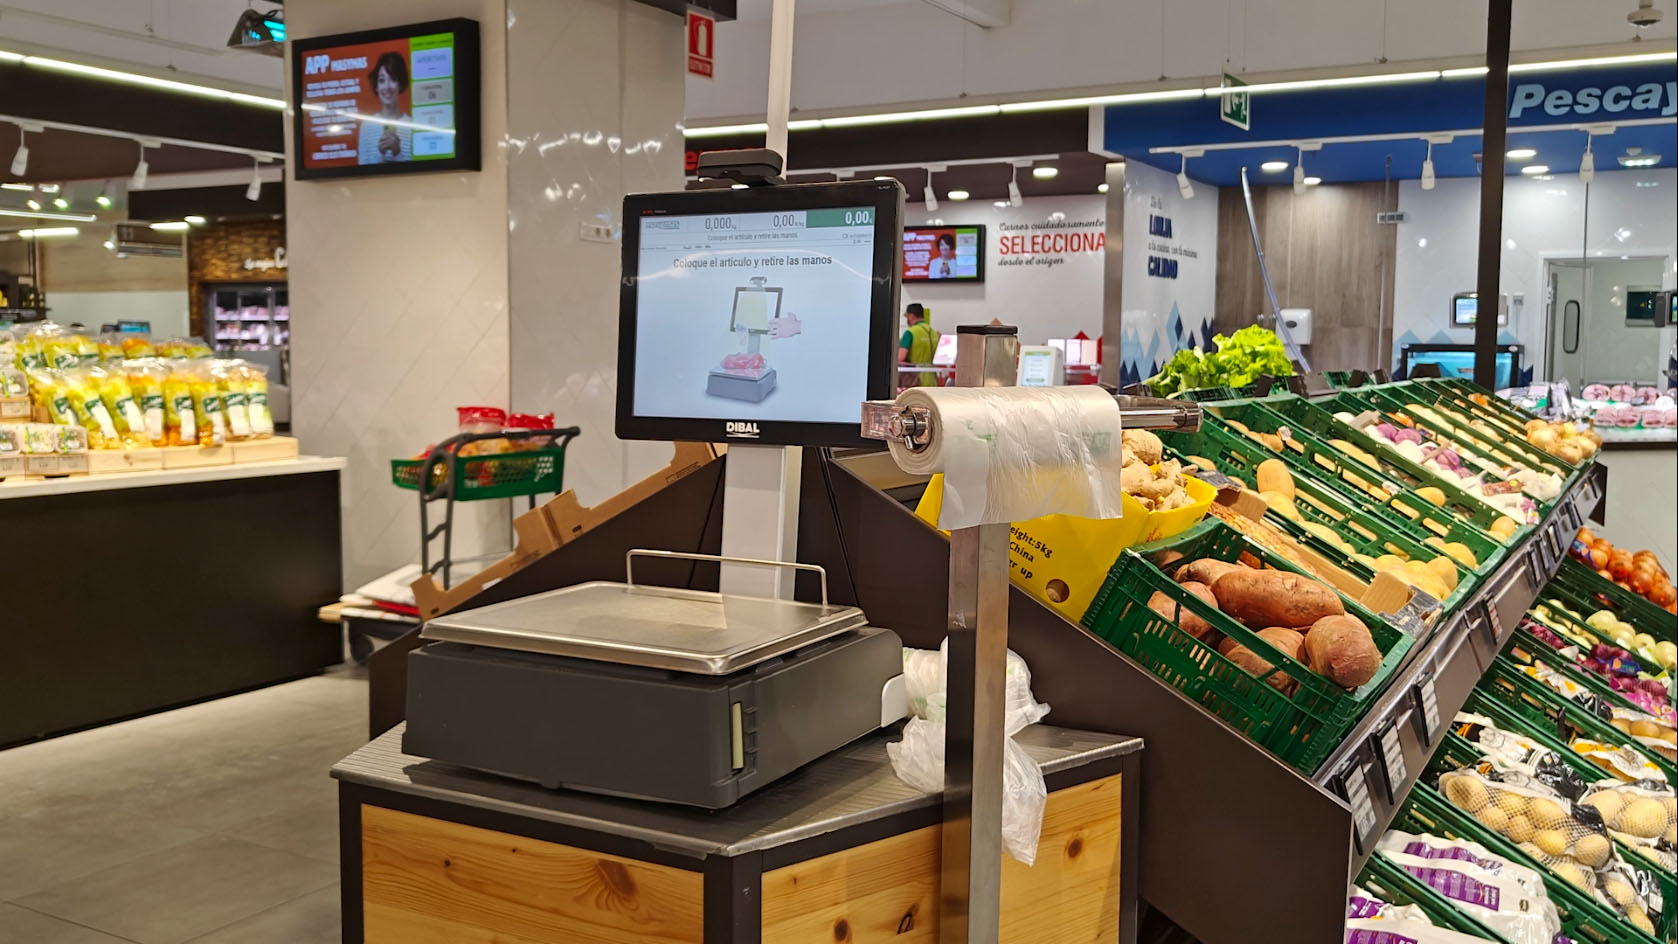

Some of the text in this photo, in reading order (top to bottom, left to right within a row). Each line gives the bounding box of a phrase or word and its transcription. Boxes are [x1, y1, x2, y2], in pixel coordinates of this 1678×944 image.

[305, 54, 330, 75] APP
[705, 217, 731, 231] 0,000
[773, 214, 795, 228] 0,00
[845, 210, 869, 226] 0,00
[1031, 218, 1105, 231] cuidadosamente
[999, 232, 1105, 256] SELECCIONA
[673, 258, 707, 269] Coloque
[710, 258, 717, 267] el
[754, 258, 759, 269] y
[761, 255, 784, 266] retire
[786, 255, 799, 265] las
[801, 256, 832, 266] manos
[726, 421, 760, 433] DIBAL
[1009, 541, 1034, 562] China
[1020, 567, 1033, 579] up
